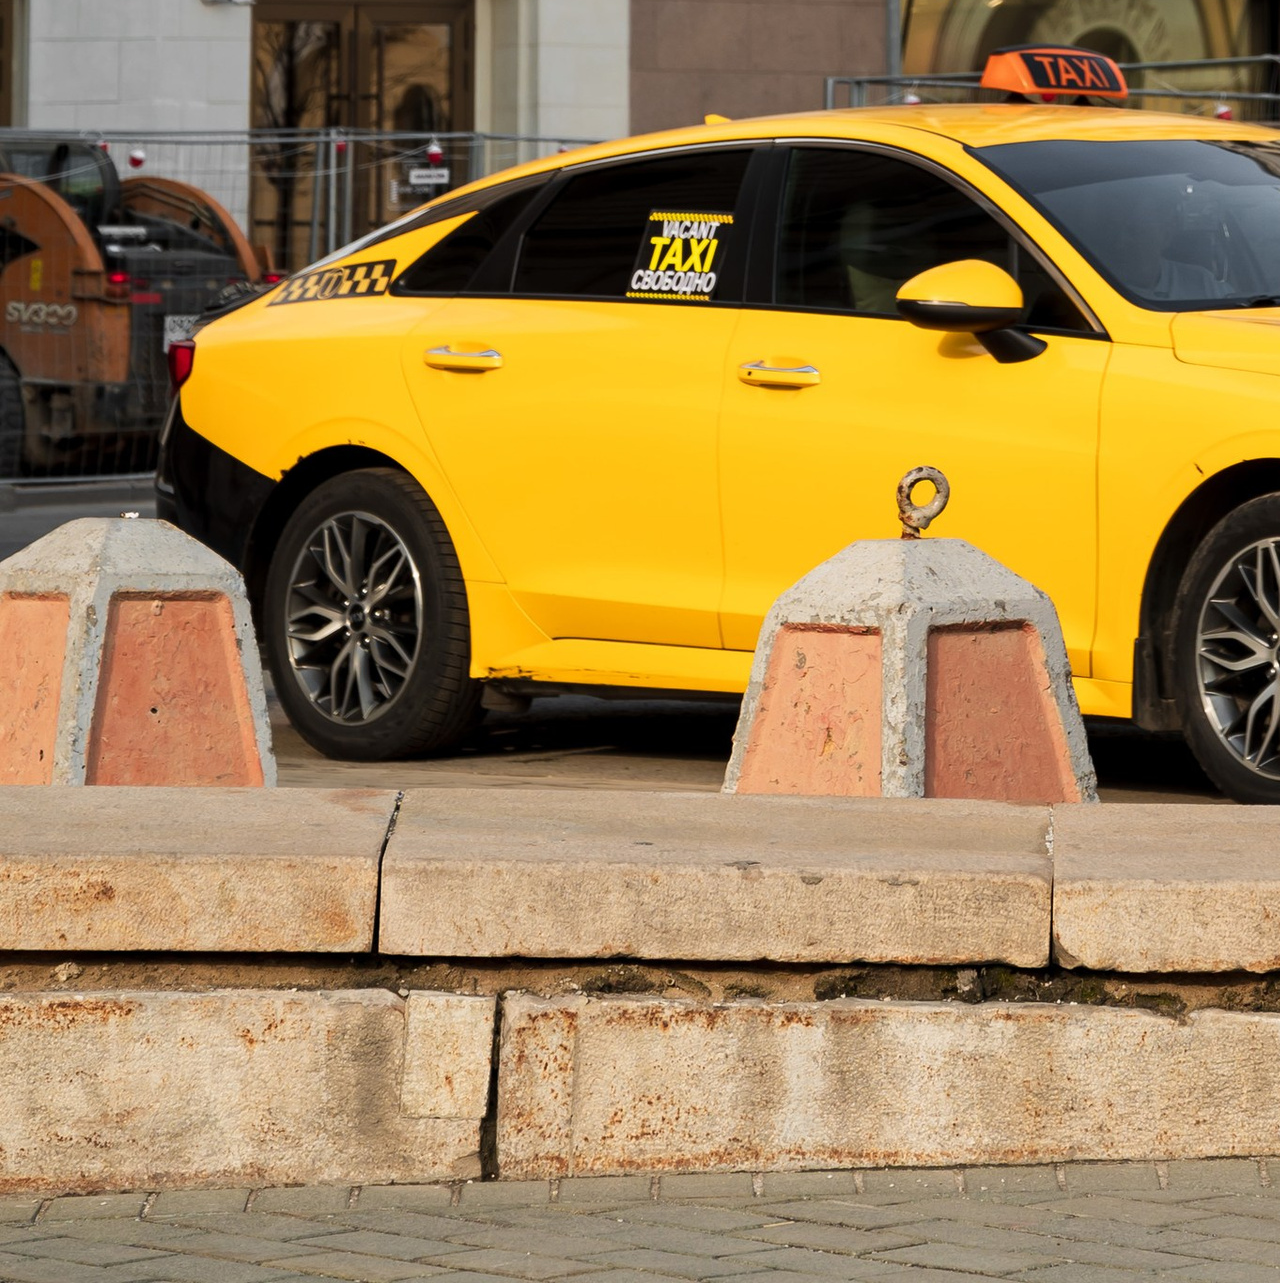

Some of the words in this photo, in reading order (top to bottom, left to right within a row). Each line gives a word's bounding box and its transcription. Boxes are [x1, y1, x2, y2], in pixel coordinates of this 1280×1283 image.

[1034, 56, 1110, 88] TAXI
[662, 220, 720, 239] VACANT
[649, 236, 718, 273] TAXI
[630, 269, 717, 295] СВОБОДНО
